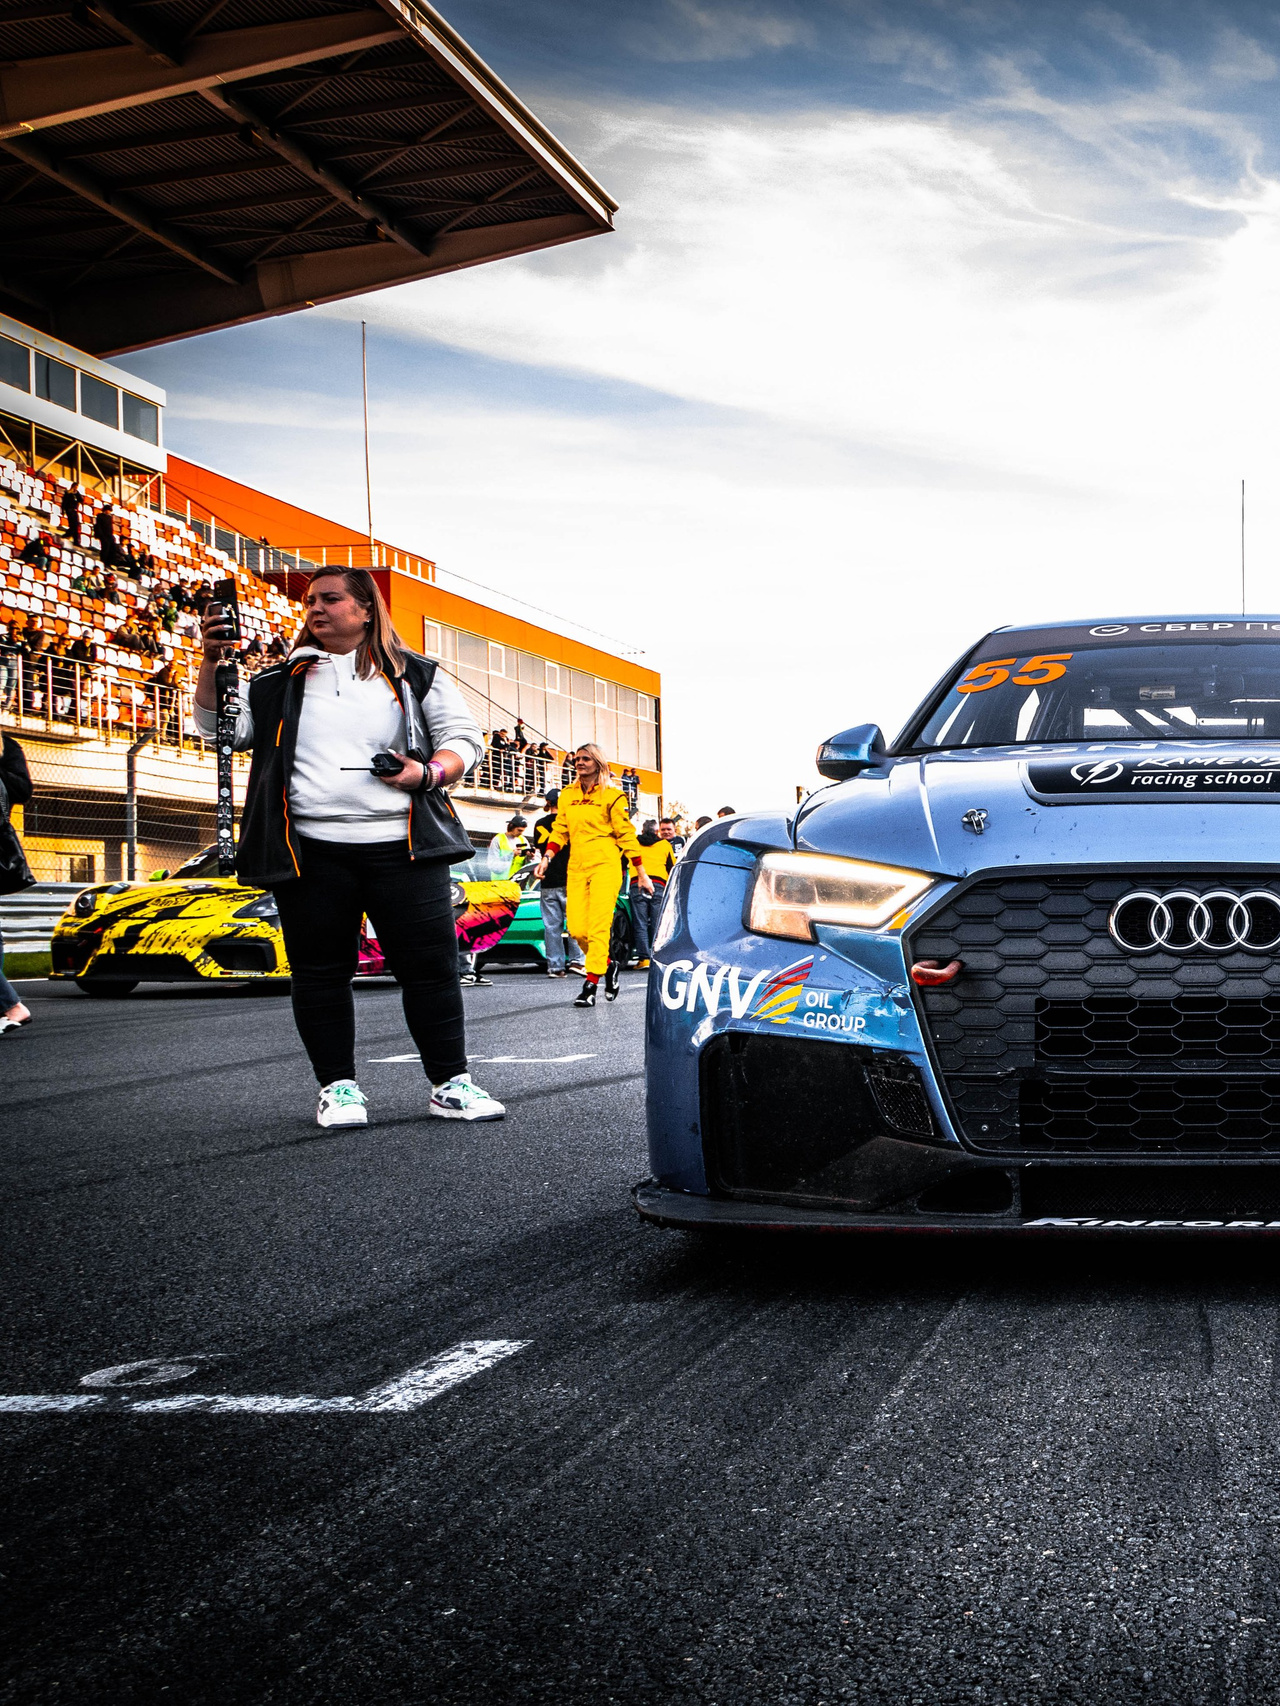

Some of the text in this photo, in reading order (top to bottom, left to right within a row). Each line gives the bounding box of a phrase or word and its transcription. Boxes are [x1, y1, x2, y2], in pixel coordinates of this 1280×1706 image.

[1139, 622, 1234, 632] СБЕР
[956, 653, 1074, 694] 55
[1131, 771, 1273, 788] racing school
[661, 959, 772, 1019] GNV
[805, 991, 834, 1009] OIL
[803, 1012, 866, 1033] GROUP
